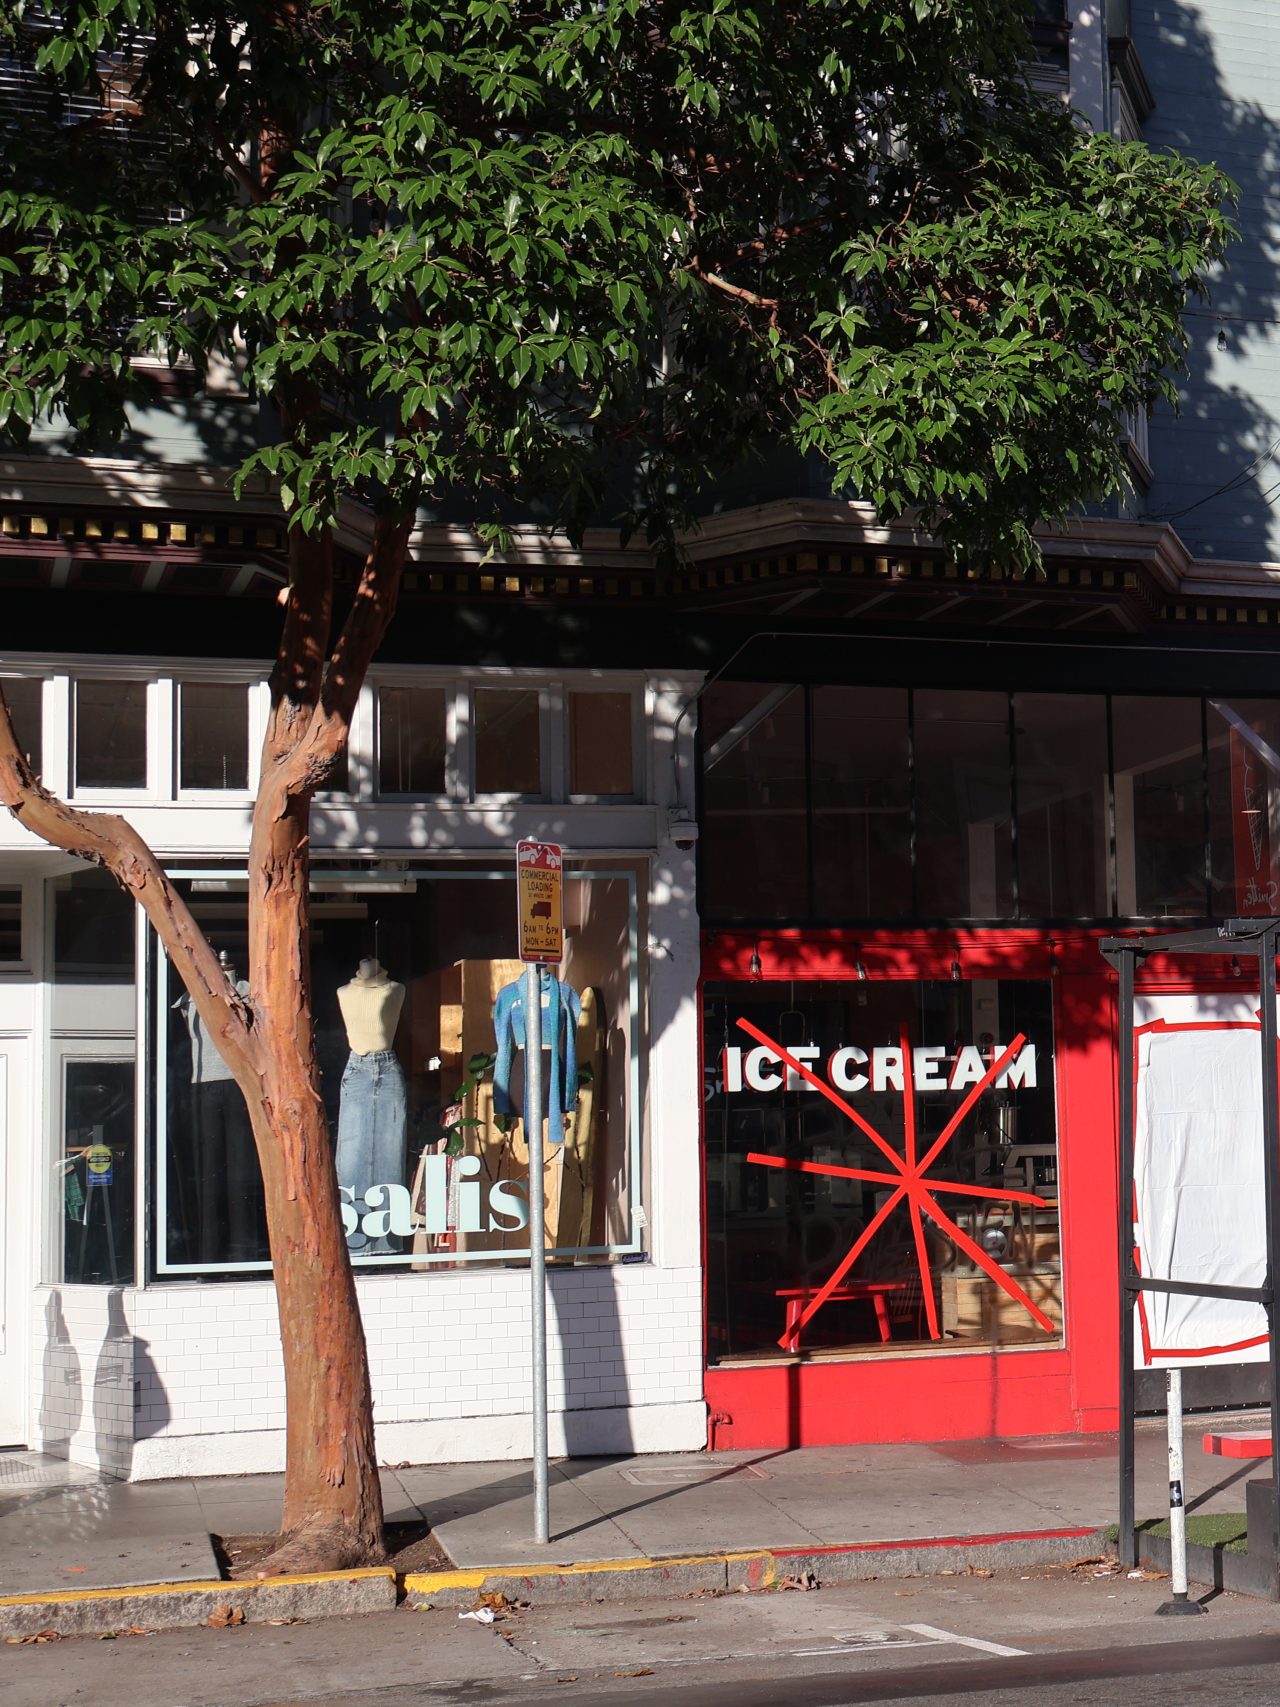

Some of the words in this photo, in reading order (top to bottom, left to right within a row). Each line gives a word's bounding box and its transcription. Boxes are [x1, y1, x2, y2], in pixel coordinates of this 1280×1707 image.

[521, 869, 558, 882] COMMERCIAL
[528, 881, 553, 892] LOADING
[524, 921, 536, 933] 6AM
[546, 922, 559, 935] 6PM
[545, 938, 556, 947] SAT
[723, 1046, 821, 1092] ICE
[828, 1044, 1038, 1092] CREAM
